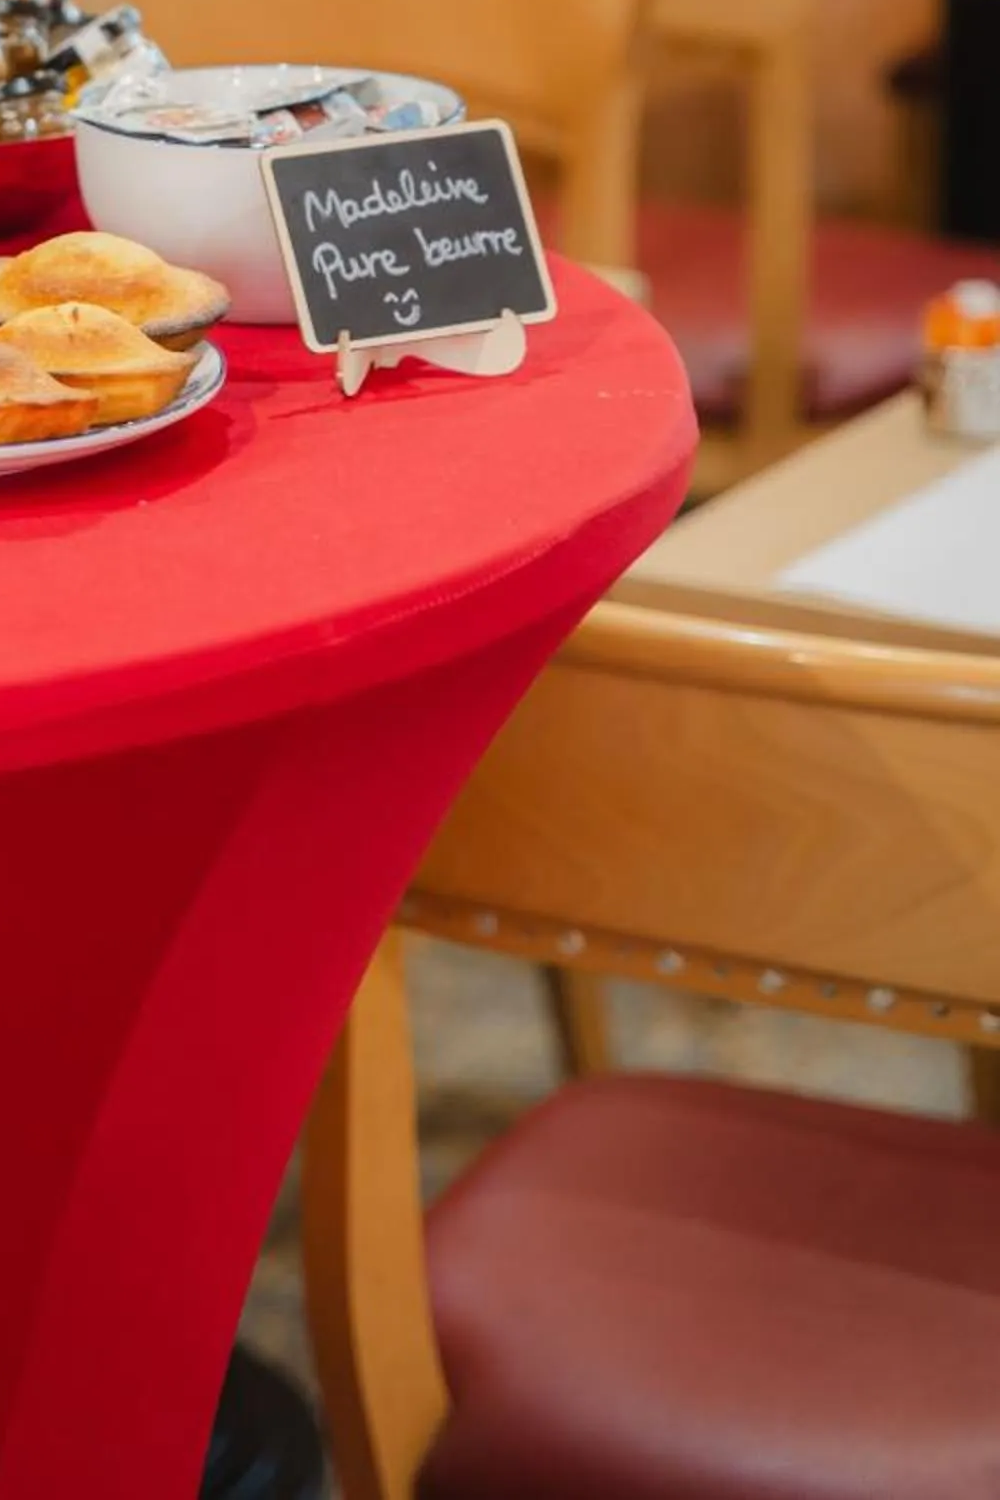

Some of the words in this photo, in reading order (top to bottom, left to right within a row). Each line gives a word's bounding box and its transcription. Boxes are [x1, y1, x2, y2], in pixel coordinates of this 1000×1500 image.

[302, 160, 489, 232] Madeleine
[312, 242, 411, 300] Pure
[413, 227, 523, 267] beurre
